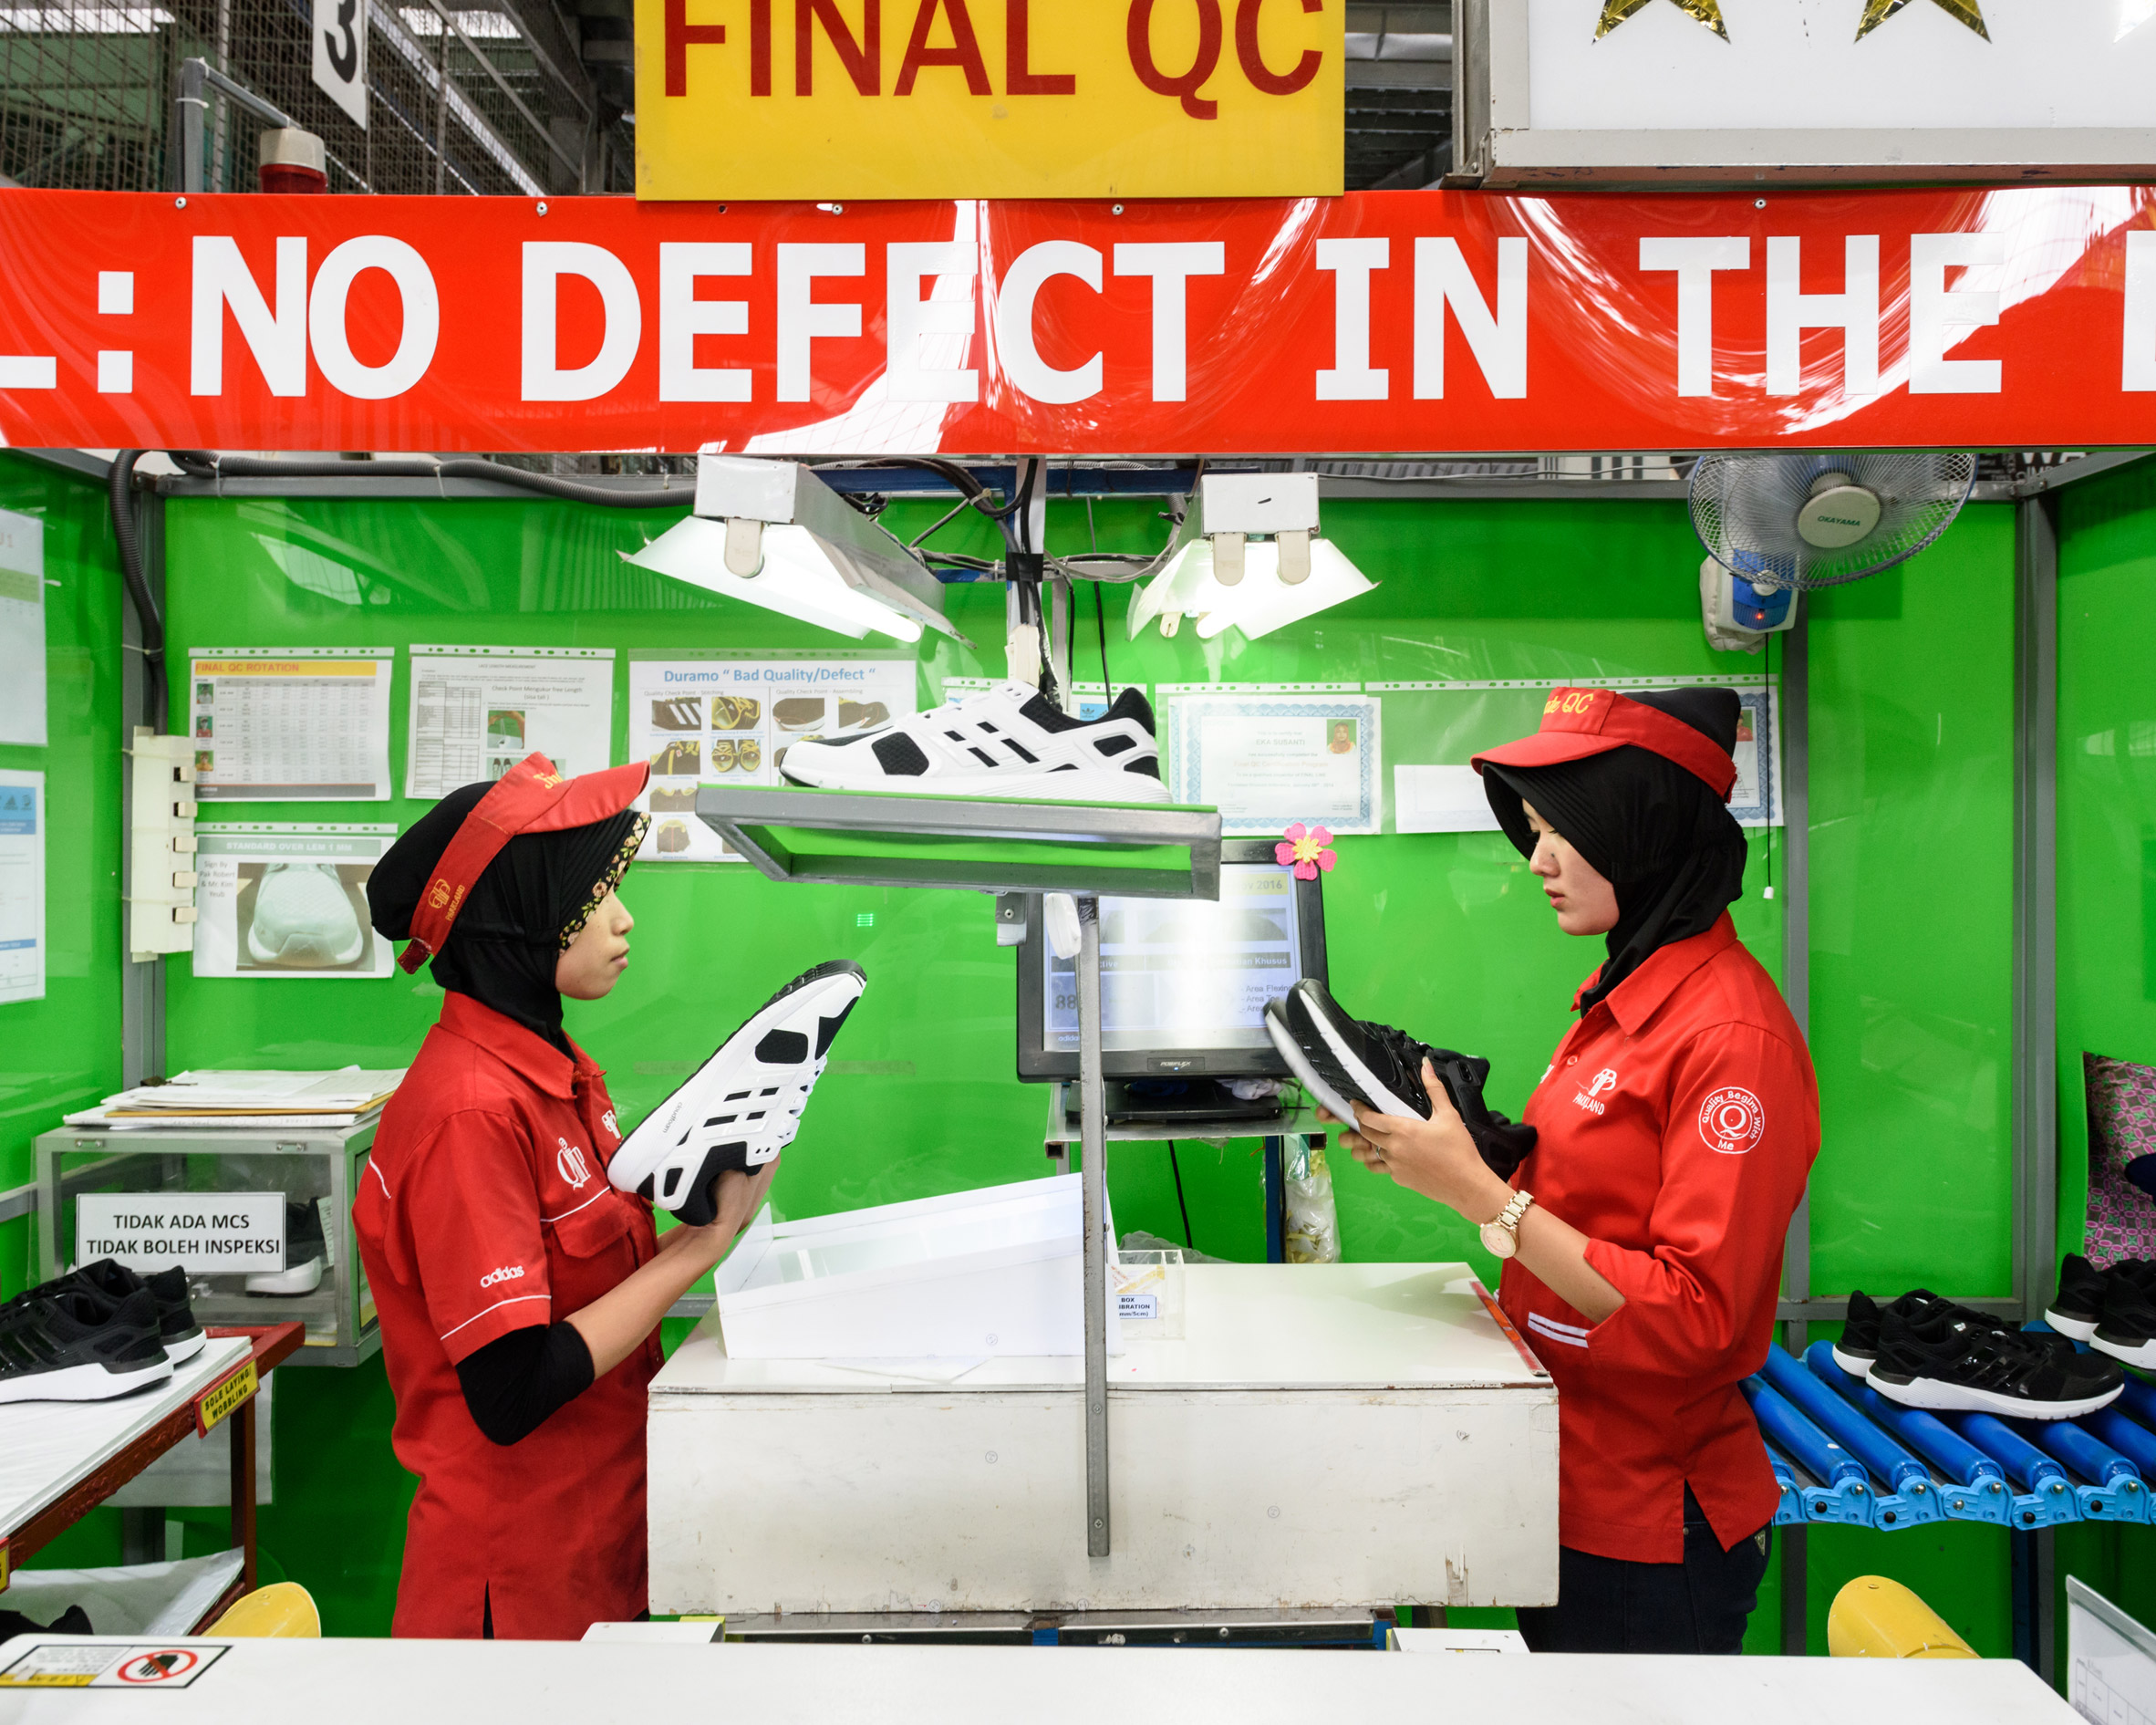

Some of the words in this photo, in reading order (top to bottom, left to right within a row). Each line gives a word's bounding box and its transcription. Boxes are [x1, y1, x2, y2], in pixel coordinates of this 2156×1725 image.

[664, 0, 1076, 98] FINAL
[1126, 0, 1322, 120] QC
[190, 234, 440, 400] NO
[521, 240, 1226, 404] DEFECT
[1315, 235, 1529, 400] IN
[1640, 233, 2004, 398] THE
[1817, 515, 1861, 526] OKAYAMA
[195, 663, 224, 672] FINAL
[228, 663, 244, 672] QC
[246, 663, 299, 672] ROTATION
[664, 670, 719, 682] Duramo
[733, 669, 760, 681] Bad
[763, 668, 865, 683] Quality/Defect
[1562, 692, 1594, 714] QC
[226, 842, 275, 850] STANDARD
[1256, 879, 1283, 890] 2016
[1254, 957, 1288, 965] Khusus
[1702, 1095, 1724, 1124] Quality
[1727, 1090, 1758, 1114] Begins
[1717, 1139, 1735, 1151] Me
[113, 1214, 165, 1229] TIDAK
[170, 1214, 206, 1229] ADA
[212, 1214, 250, 1229] MCS
[87, 1240, 138, 1254] TIDAK
[143, 1240, 199, 1254] BOLEH
[205, 1240, 280, 1254] INSPEKSI
[480, 1264, 524, 1288] adidas
[205, 1389, 223, 1411] SOLE
[212, 1384, 248, 1419] WOBBLING
